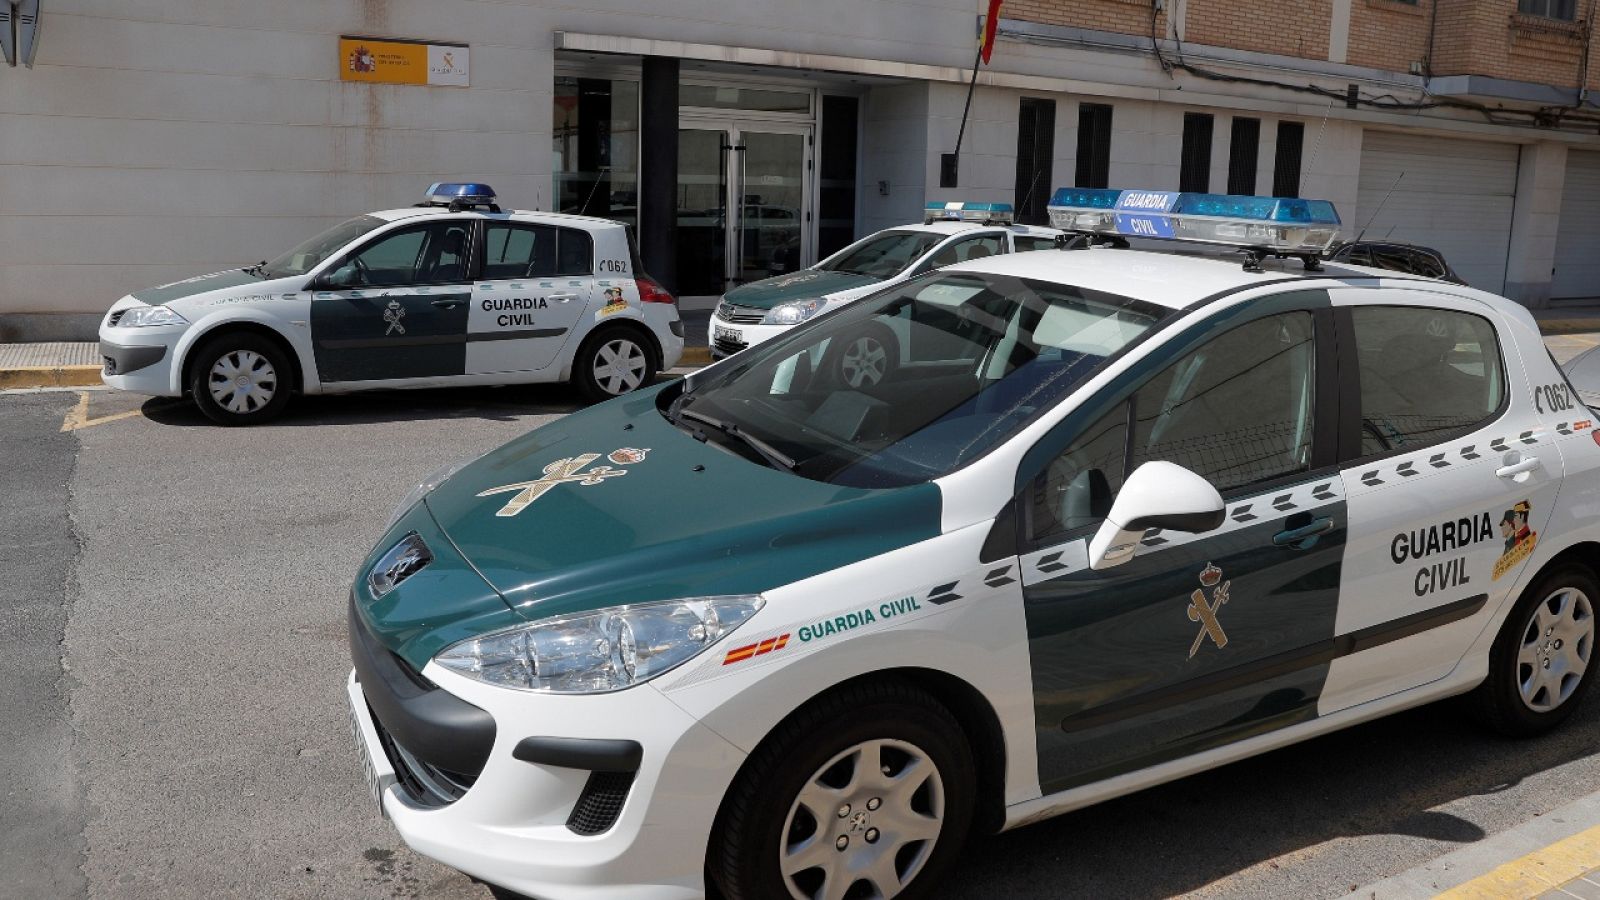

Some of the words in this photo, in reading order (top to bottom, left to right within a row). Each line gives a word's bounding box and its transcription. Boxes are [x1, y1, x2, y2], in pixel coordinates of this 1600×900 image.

[1123, 193, 1168, 209] GUARDIA
[1130, 218, 1158, 235] CIVIL
[608, 260, 627, 273] 062
[482, 297, 548, 311] GUARDIA
[497, 313, 535, 326] CIVIL
[1543, 383, 1574, 413] 062
[1391, 512, 1493, 564] GUARDIA
[1414, 557, 1470, 596] CIVIL
[798, 609, 876, 642] GUARDIA
[880, 596, 921, 618] CIVIL
